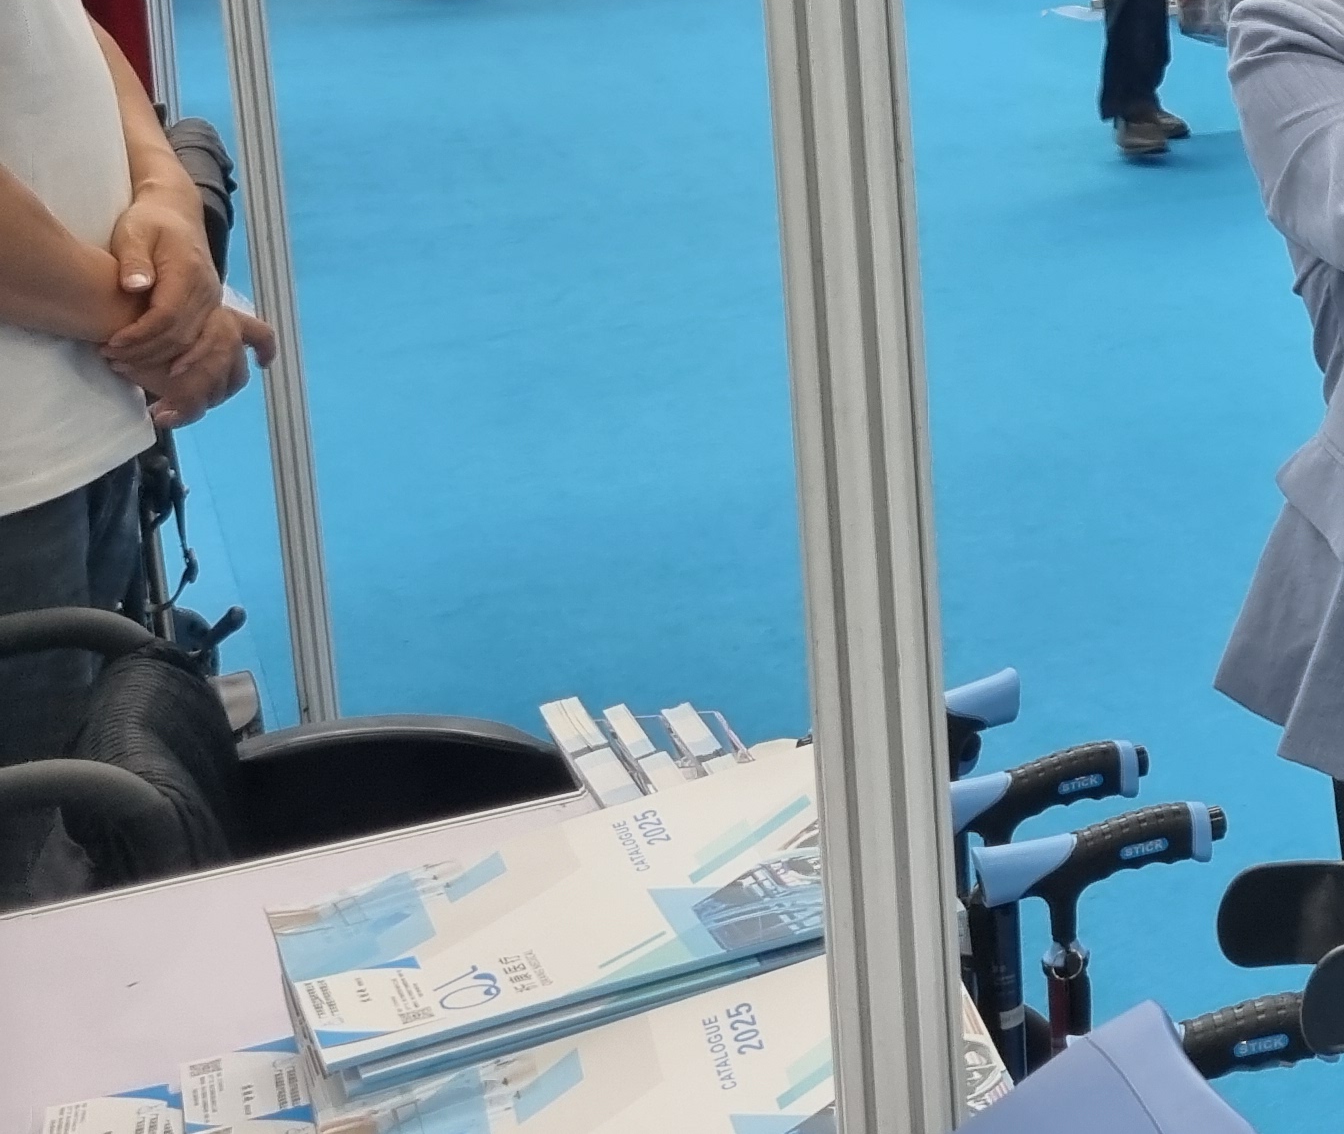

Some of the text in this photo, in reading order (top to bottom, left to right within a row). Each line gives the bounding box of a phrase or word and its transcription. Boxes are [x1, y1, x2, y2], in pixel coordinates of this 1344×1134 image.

[1061, 774, 1099, 794] STICK
[612, 820, 651, 872] CATALOGUE
[633, 809, 672, 846] 2025
[1124, 839, 1165, 857] STICK
[725, 1002, 765, 1056] 2025
[1238, 1036, 1285, 1055] STICK
[701, 1015, 738, 1091] CATALOGUE
